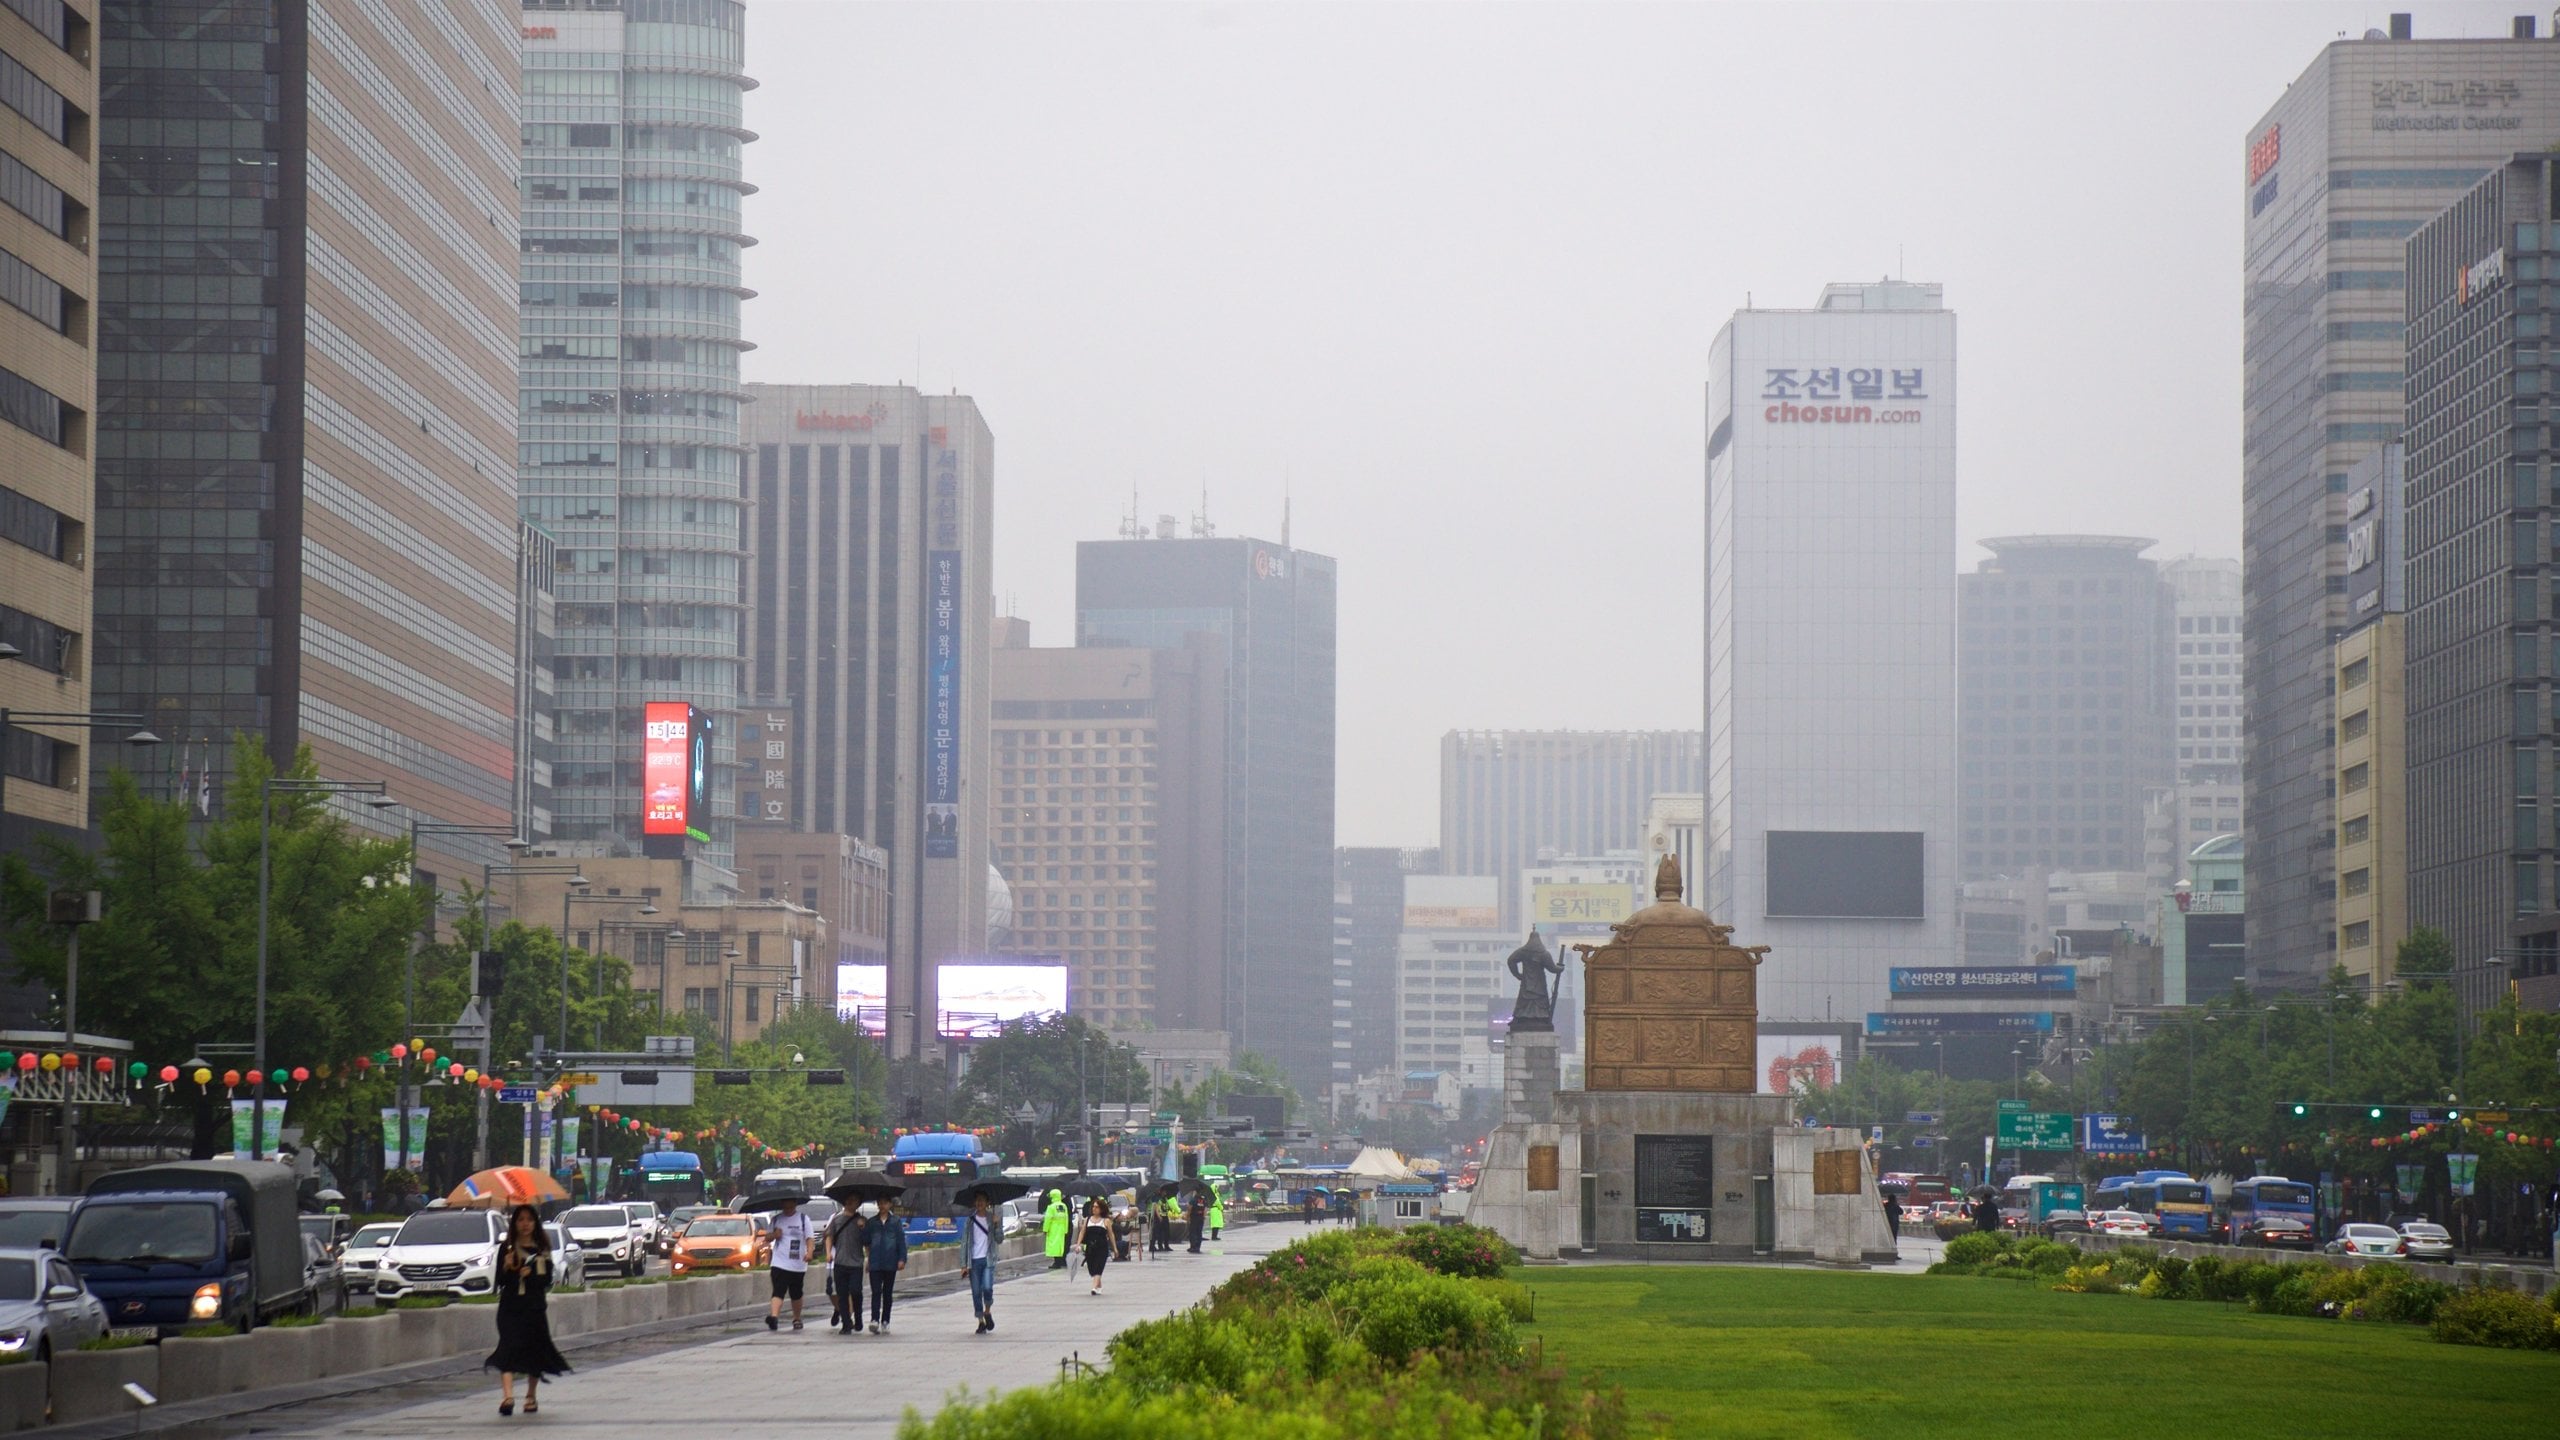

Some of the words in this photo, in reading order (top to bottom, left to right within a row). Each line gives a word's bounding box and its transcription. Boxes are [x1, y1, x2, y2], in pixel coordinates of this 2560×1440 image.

[2371, 79, 2520, 108] 감리교본부
[2371, 115, 2458, 131] Methodist
[2463, 116, 2522, 130] Center
[1761, 367, 1928, 399] 조선일보
[796, 409, 873, 431] kobaco
[1764, 401, 1921, 424] chosun.com
[939, 560, 951, 595] 한반도
[936, 599, 953, 630] 봄이
[934, 729, 952, 748] 문
[1911, 973, 1956, 985] 신한은행
[1961, 973, 2037, 985] 청소년금융교육센터
